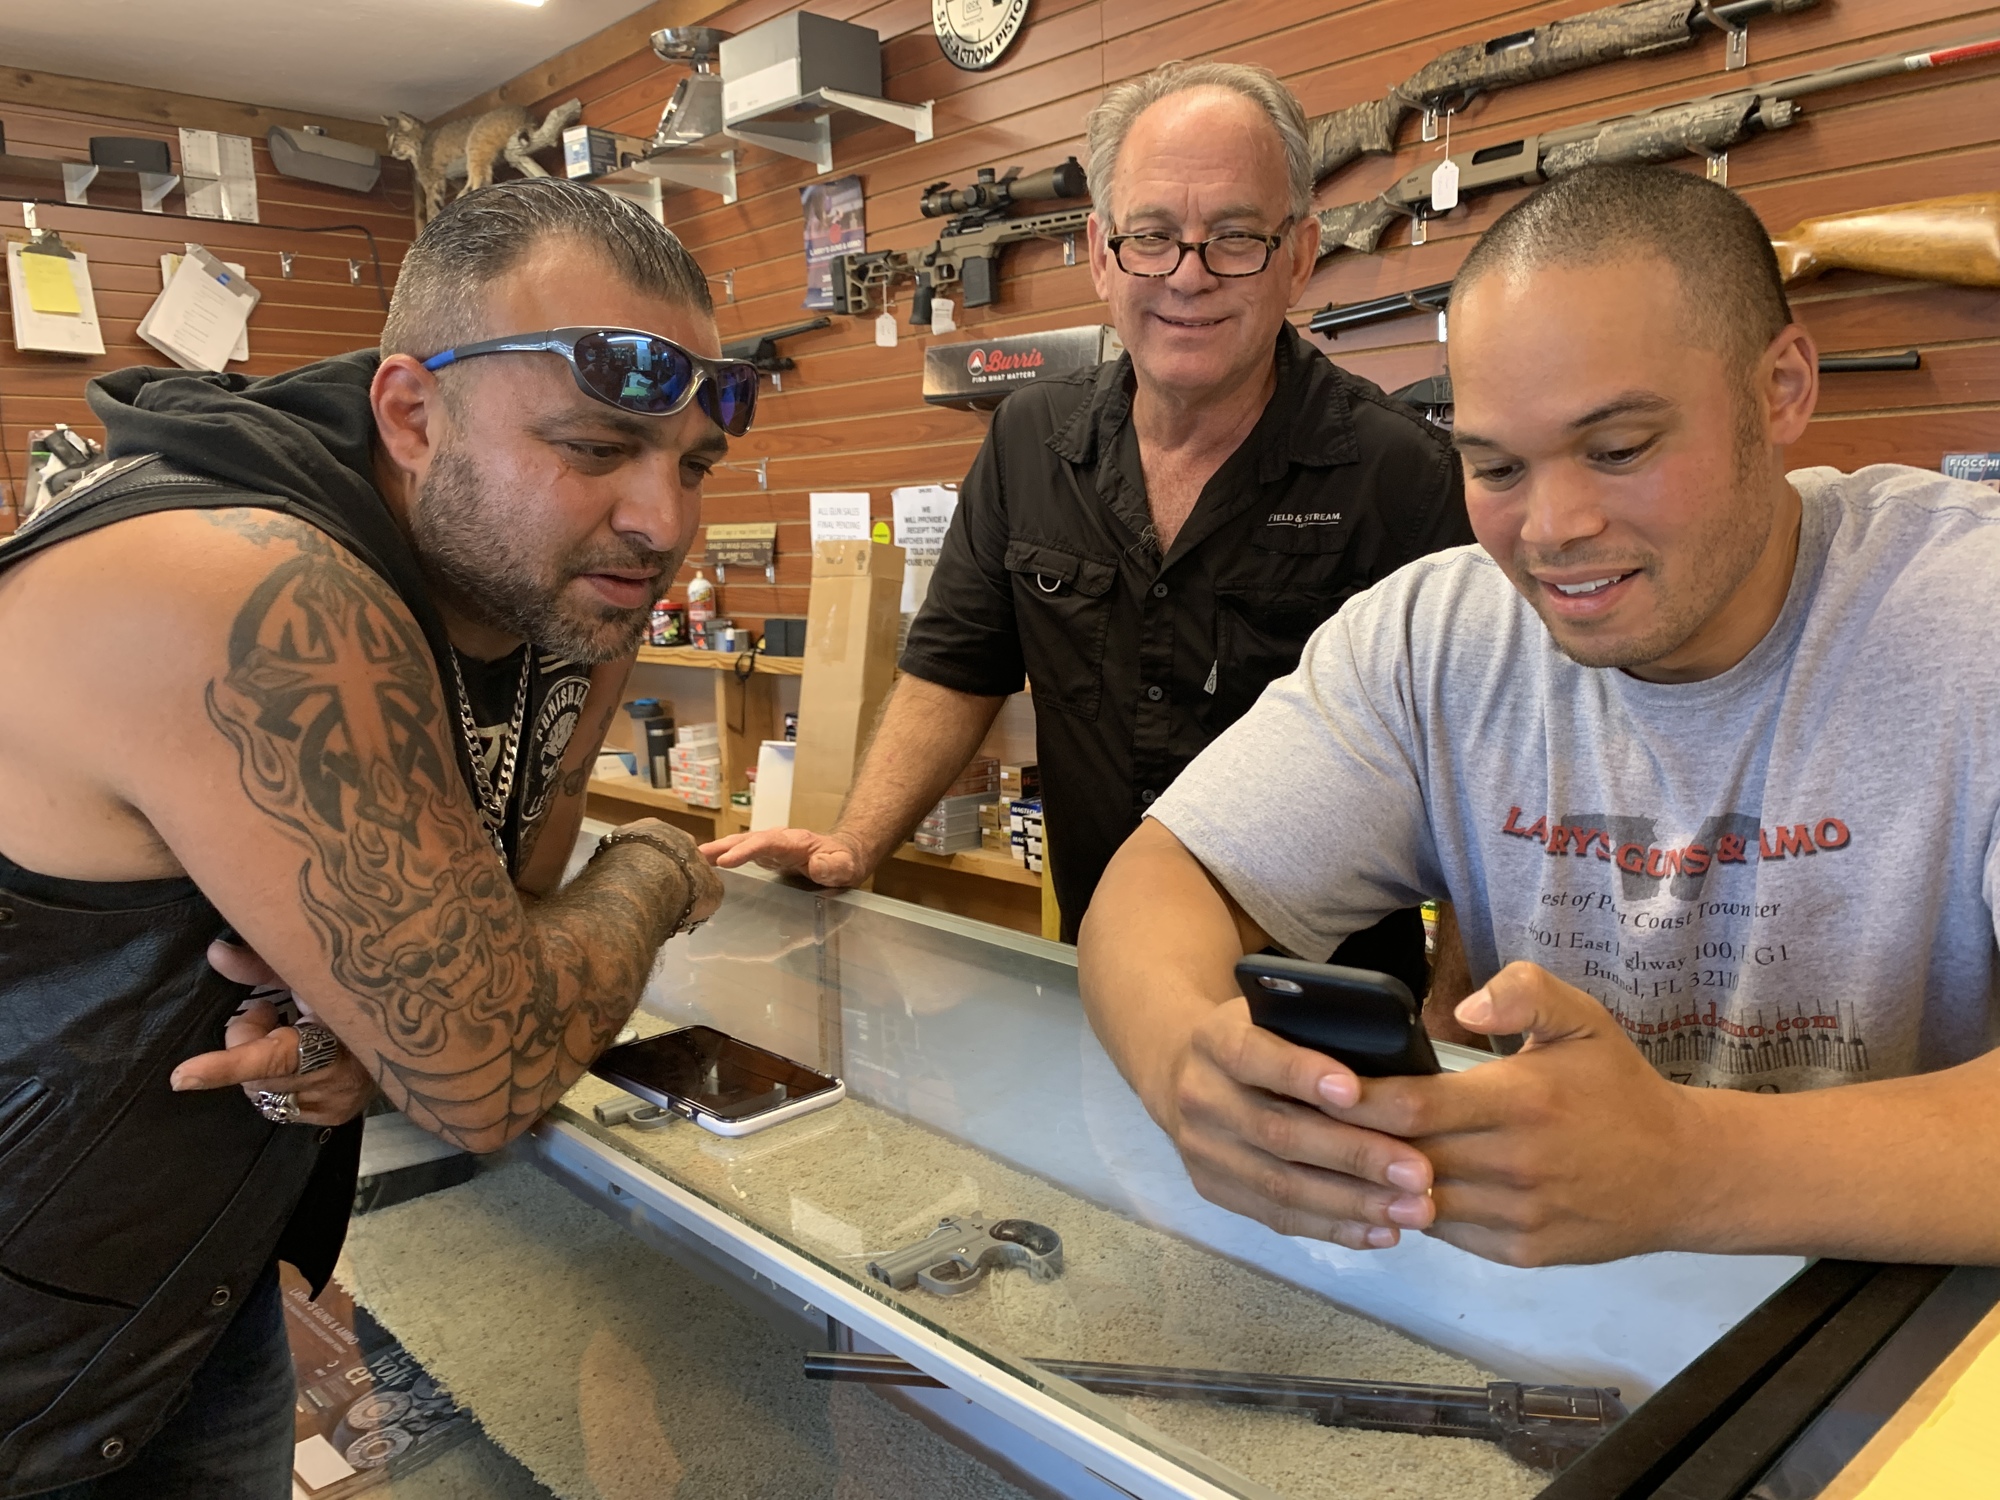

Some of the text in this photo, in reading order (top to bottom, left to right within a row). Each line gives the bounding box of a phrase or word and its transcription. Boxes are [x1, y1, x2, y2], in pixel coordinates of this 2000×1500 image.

[952, 42, 994, 63] ACTION
[984, 348, 1045, 372] Burris
[972, 370, 1036, 384] FIND WHAT MATTERS
[1949, 458, 2000, 467] FIOCCHI
[1268, 513, 1294, 522] FIELD
[1295, 514, 1303, 523] &
[1616, 842, 1712, 879] GUNS
[1717, 831, 1748, 865] &
[1571, 892, 1596, 912] of
[1634, 910, 1693, 930] Coast
[1569, 931, 1612, 953] East
[1652, 979, 1683, 998] FL
[345, 1366, 377, 1386] er
